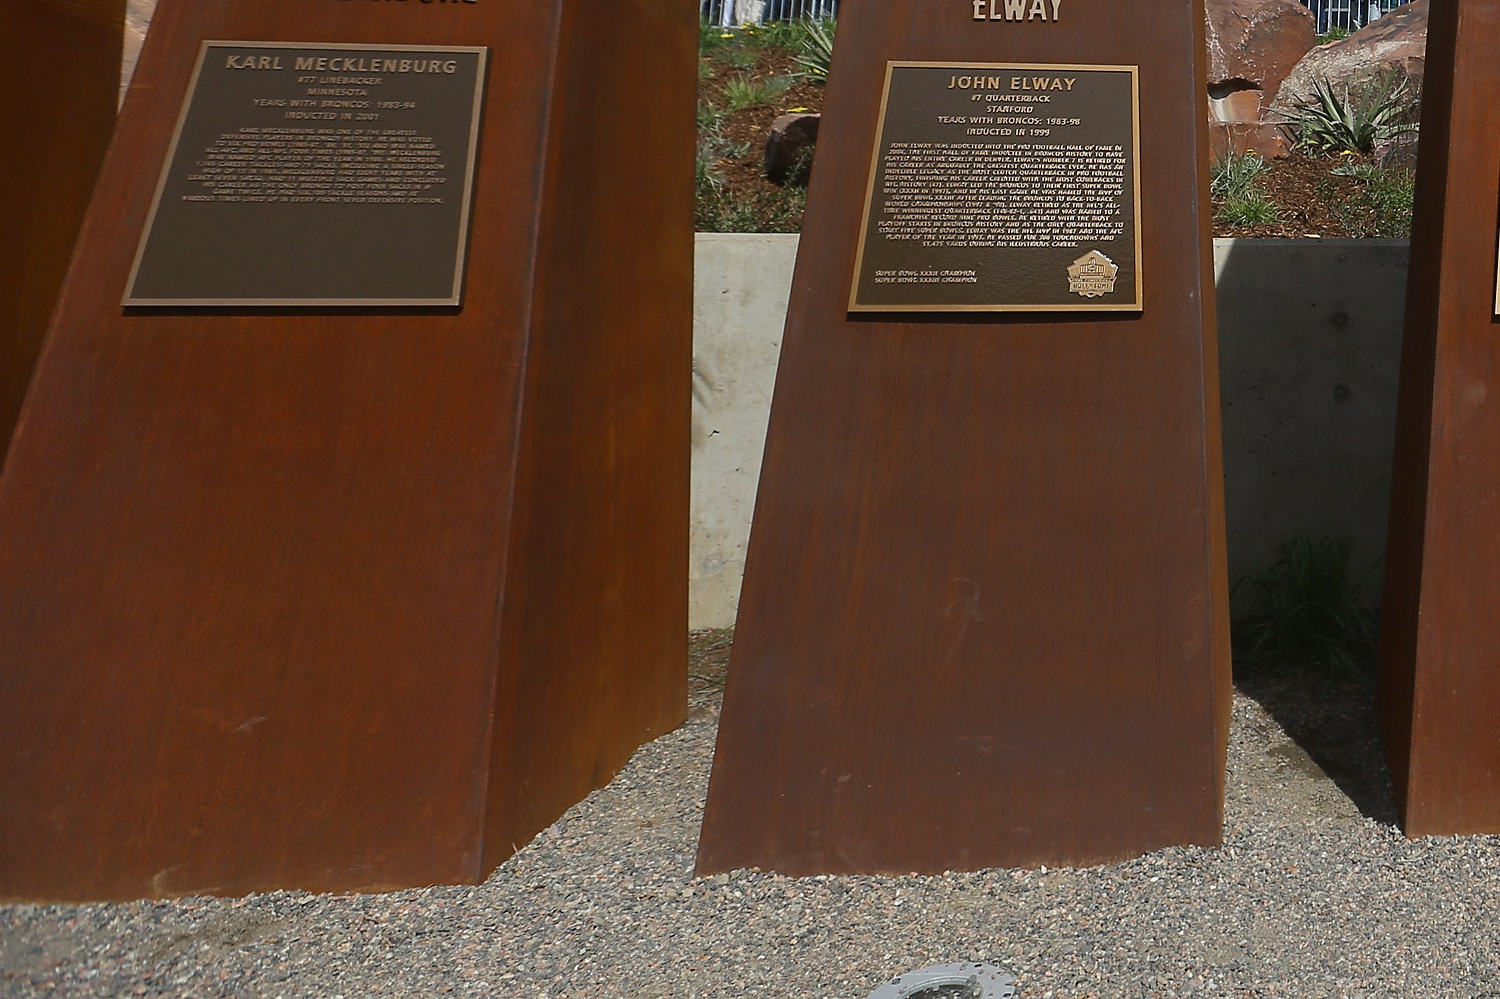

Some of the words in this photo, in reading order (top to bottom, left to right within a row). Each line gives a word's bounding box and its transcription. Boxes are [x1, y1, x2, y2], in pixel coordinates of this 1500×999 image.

[226, 55, 283, 70] KARL
[294, 57, 457, 74] MECKLENBURG
[319, 77, 382, 85] LINEBACKER
[948, 76, 1000, 89] JOHN
[1010, 76, 1076, 90] ELWAY
[307, 88, 367, 96] MINNESOTA
[253, 98, 286, 107] YEARS
[290, 99, 317, 107] WITH
[284, 111, 336, 120] INDUCTED
[341, 112, 352, 120] IN
